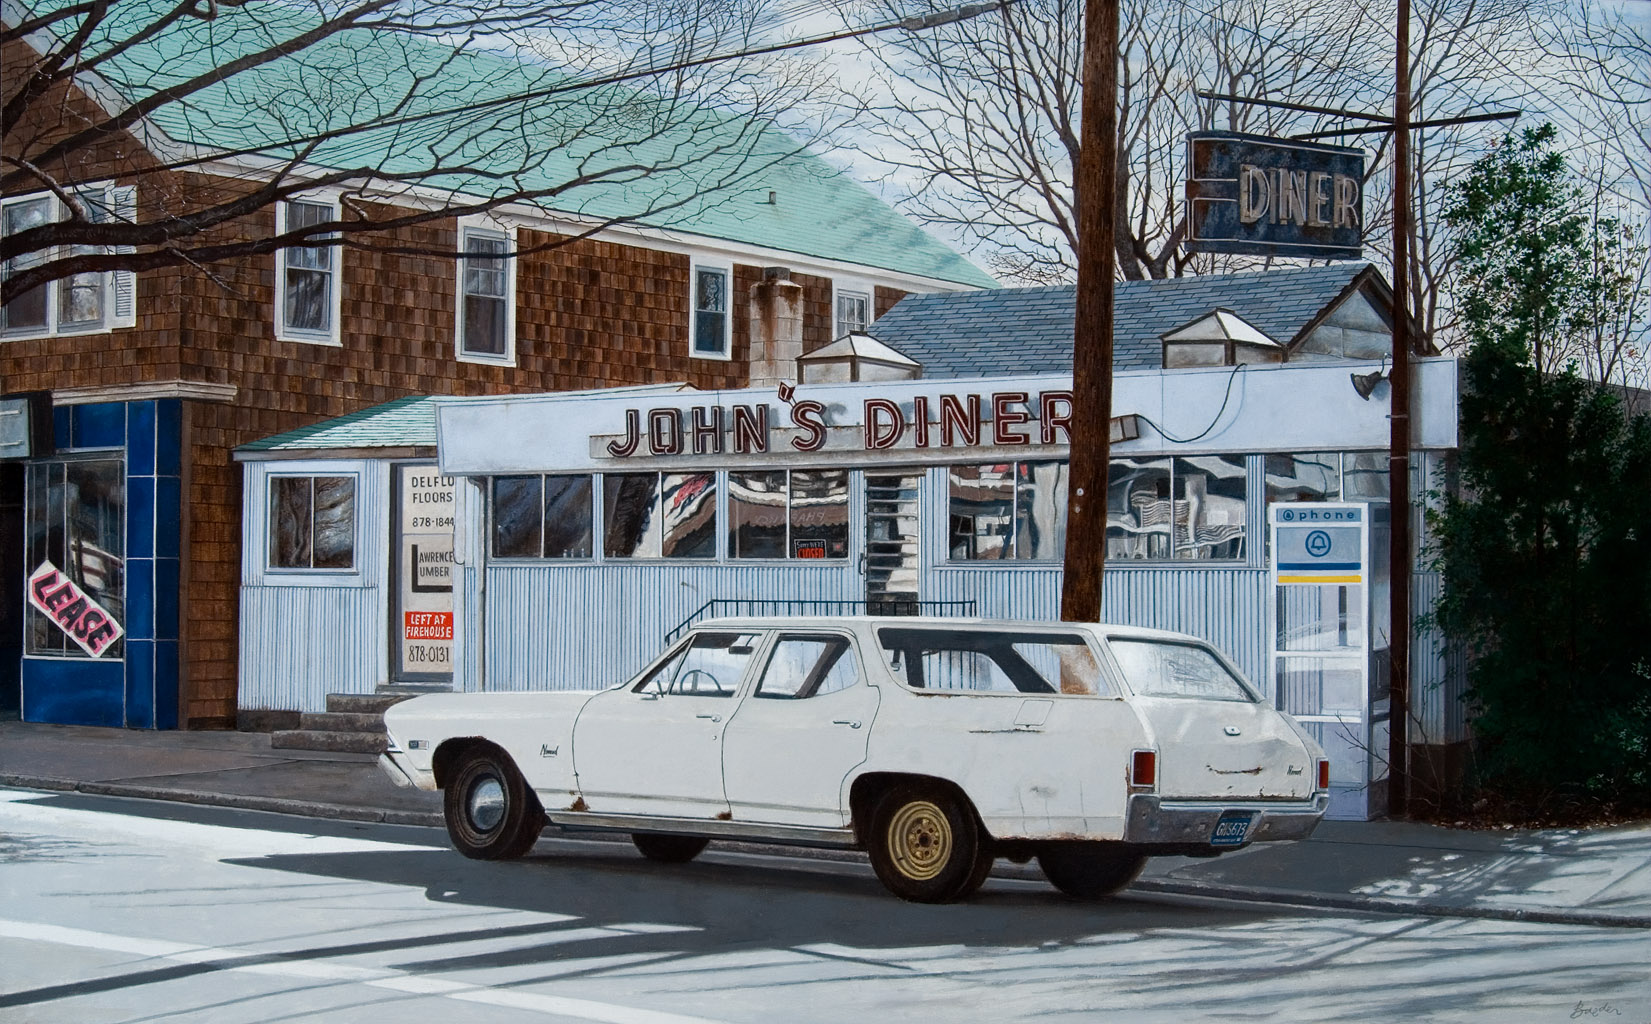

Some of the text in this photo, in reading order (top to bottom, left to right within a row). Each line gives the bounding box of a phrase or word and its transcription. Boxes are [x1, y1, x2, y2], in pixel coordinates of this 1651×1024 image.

[1239, 163, 1359, 229] DINER
[607, 380, 1073, 457] JOHN'S DINER
[412, 492, 453, 503] FLOORS
[1299, 510, 1354, 521] phone
[412, 516, 454, 527] 878-1844
[32, 569, 117, 654] LEASE
[410, 614, 446, 625] LEFT AT
[406, 626, 451, 638] FIREHOUSE
